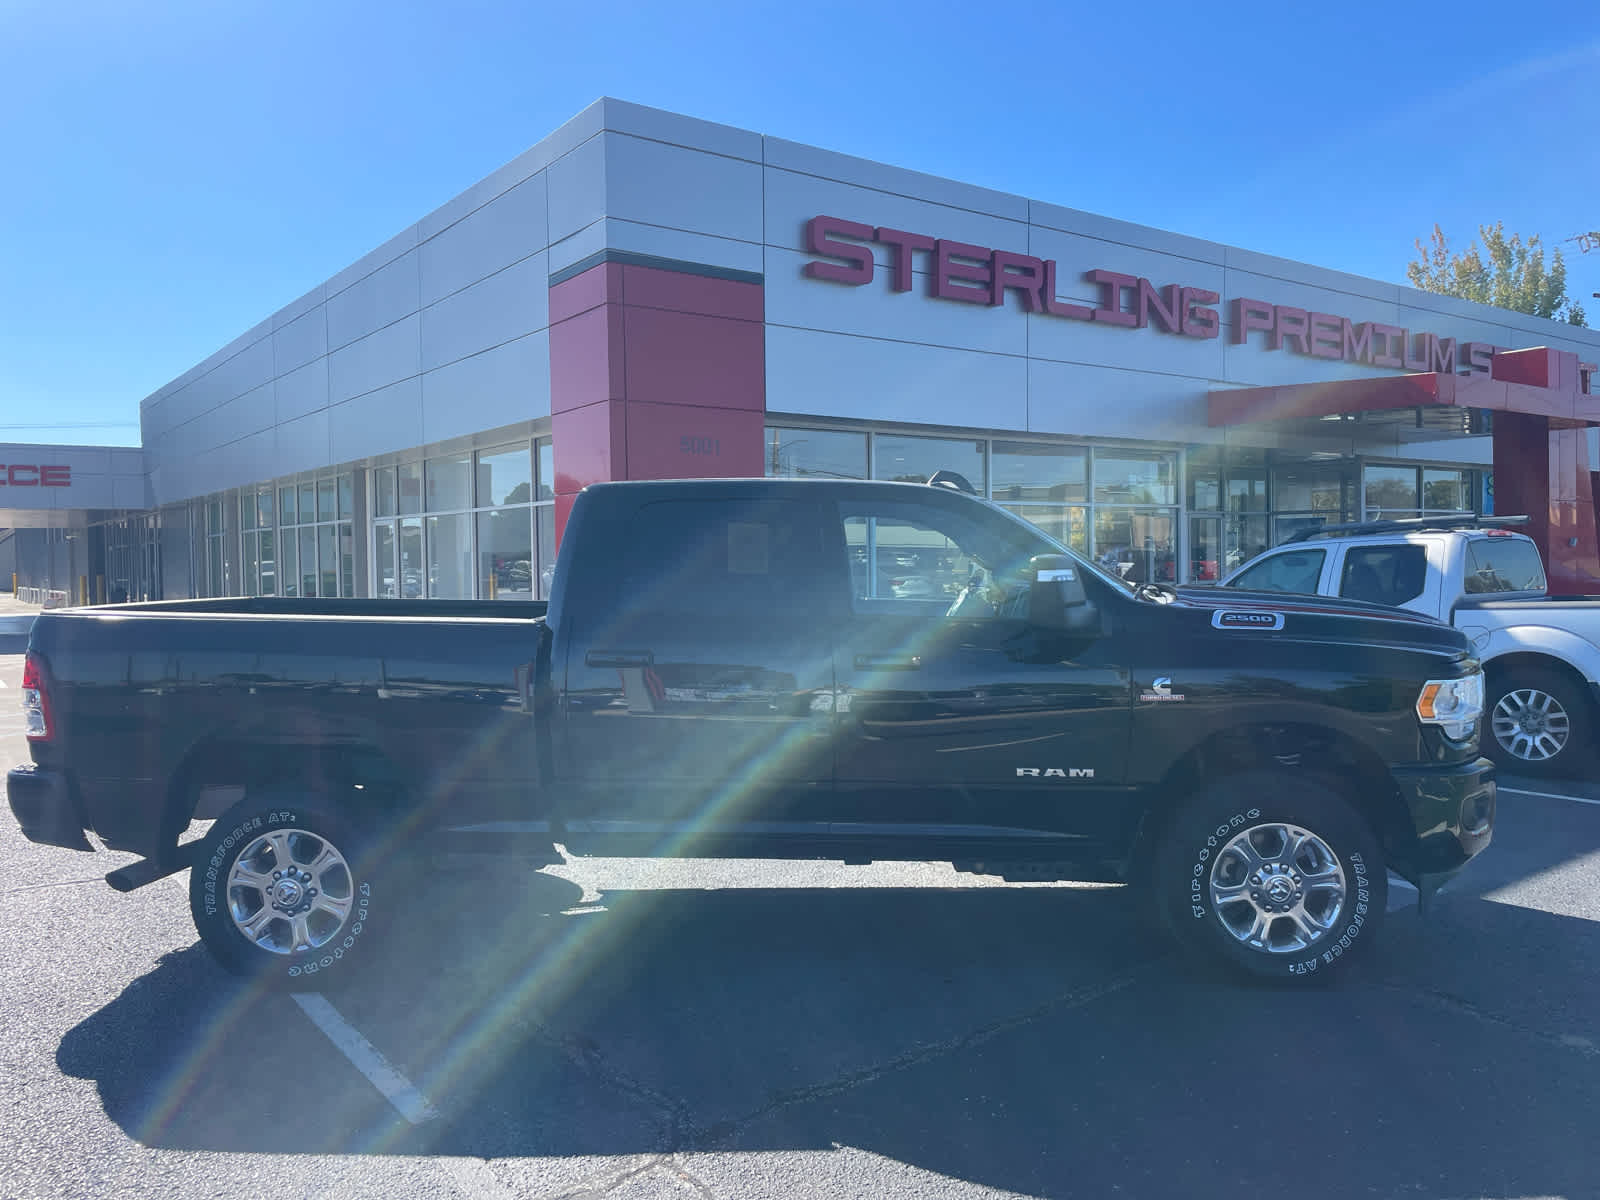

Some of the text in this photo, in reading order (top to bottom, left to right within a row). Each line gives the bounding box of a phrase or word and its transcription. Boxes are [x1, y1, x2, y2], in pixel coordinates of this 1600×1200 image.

[806, 215, 1219, 339] STERLING
[1232, 297, 1456, 374] PREMIUM
[1224, 614, 1273, 622] 2500
[1016, 768, 1095, 777] RAM
[205, 817, 262, 915] TRANSFORCE
[1323, 852, 1369, 963] TRANSFORCE
